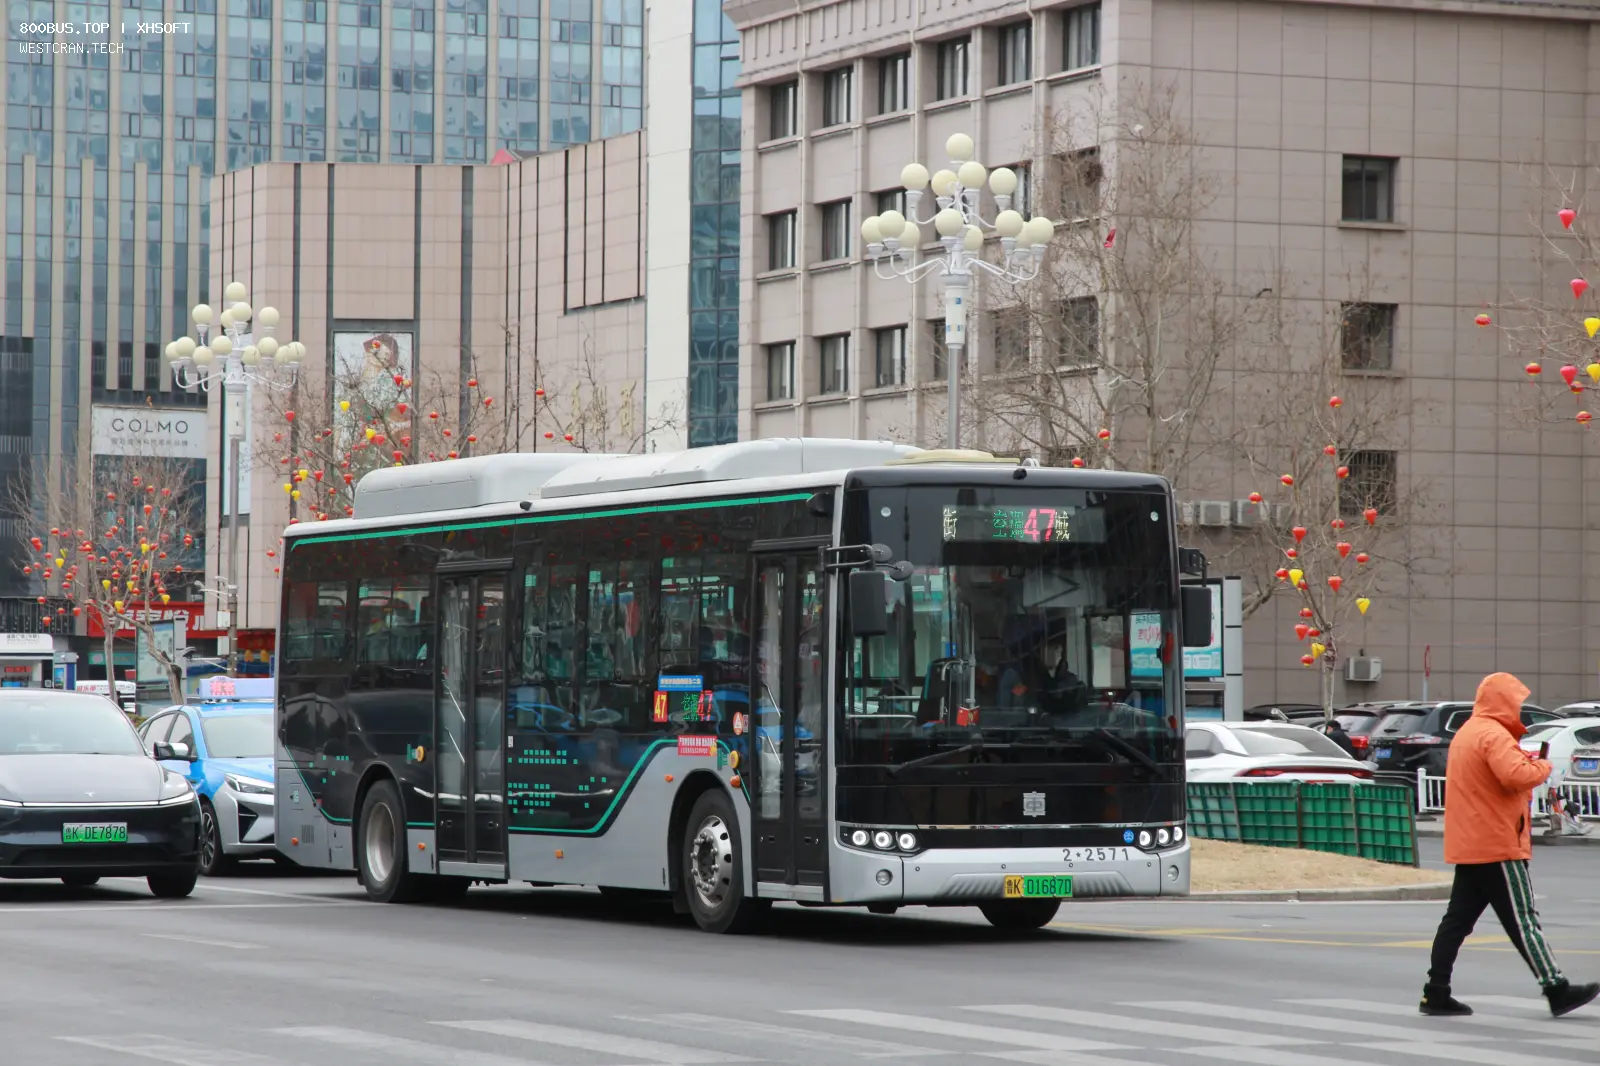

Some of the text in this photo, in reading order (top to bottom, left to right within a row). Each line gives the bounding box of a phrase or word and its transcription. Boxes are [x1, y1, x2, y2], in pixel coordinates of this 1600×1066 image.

[111, 418, 189, 434] COLMO
[1024, 508, 1056, 542] 47
[655, 695, 667, 719] 47
[85, 826, 126, 840] DE7878
[1027, 878, 1072, 895] 01687D
